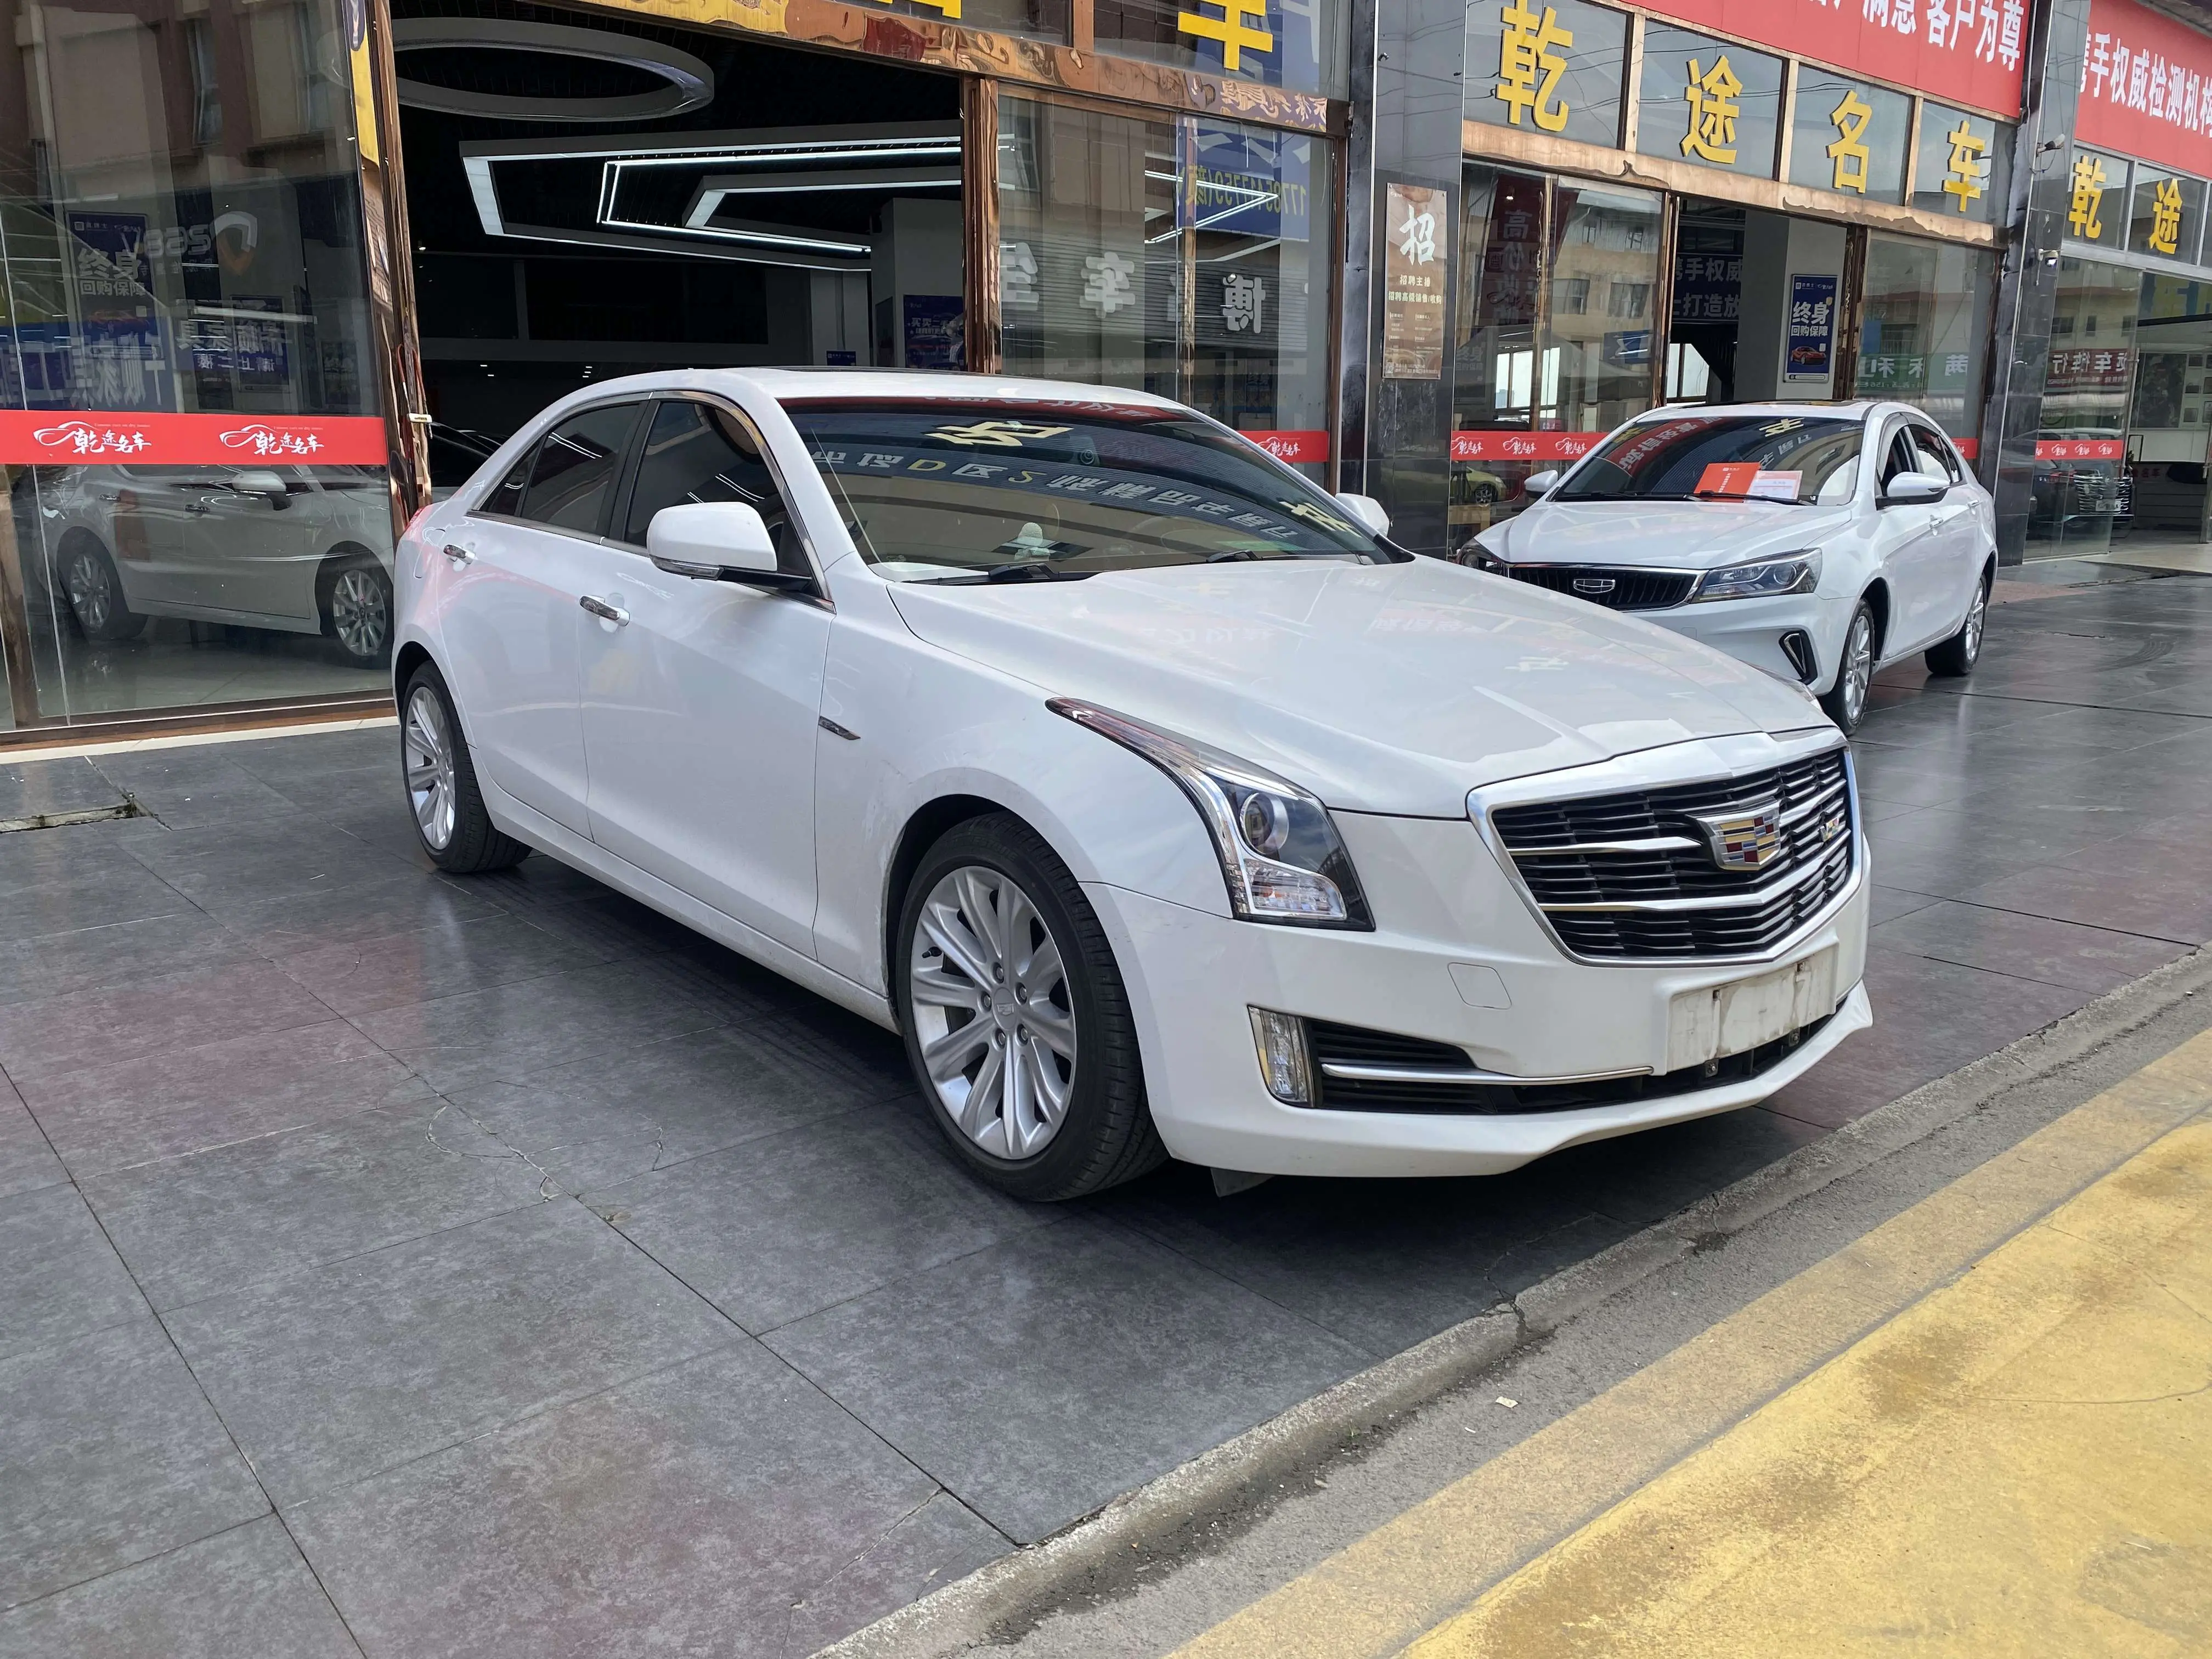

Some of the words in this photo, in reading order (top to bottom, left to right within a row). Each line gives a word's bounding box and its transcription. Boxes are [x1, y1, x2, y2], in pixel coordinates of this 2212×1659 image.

[1400, 204, 1435, 266] 招
[77, 248, 141, 278] 终身
[81, 280, 146, 296] 回购保障
[1792, 301, 1829, 324] 终身
[1791, 325, 1828, 337] 回购保障
[72, 428, 151, 454] 乾途名车
[256, 430, 324, 455] 乾途名车
